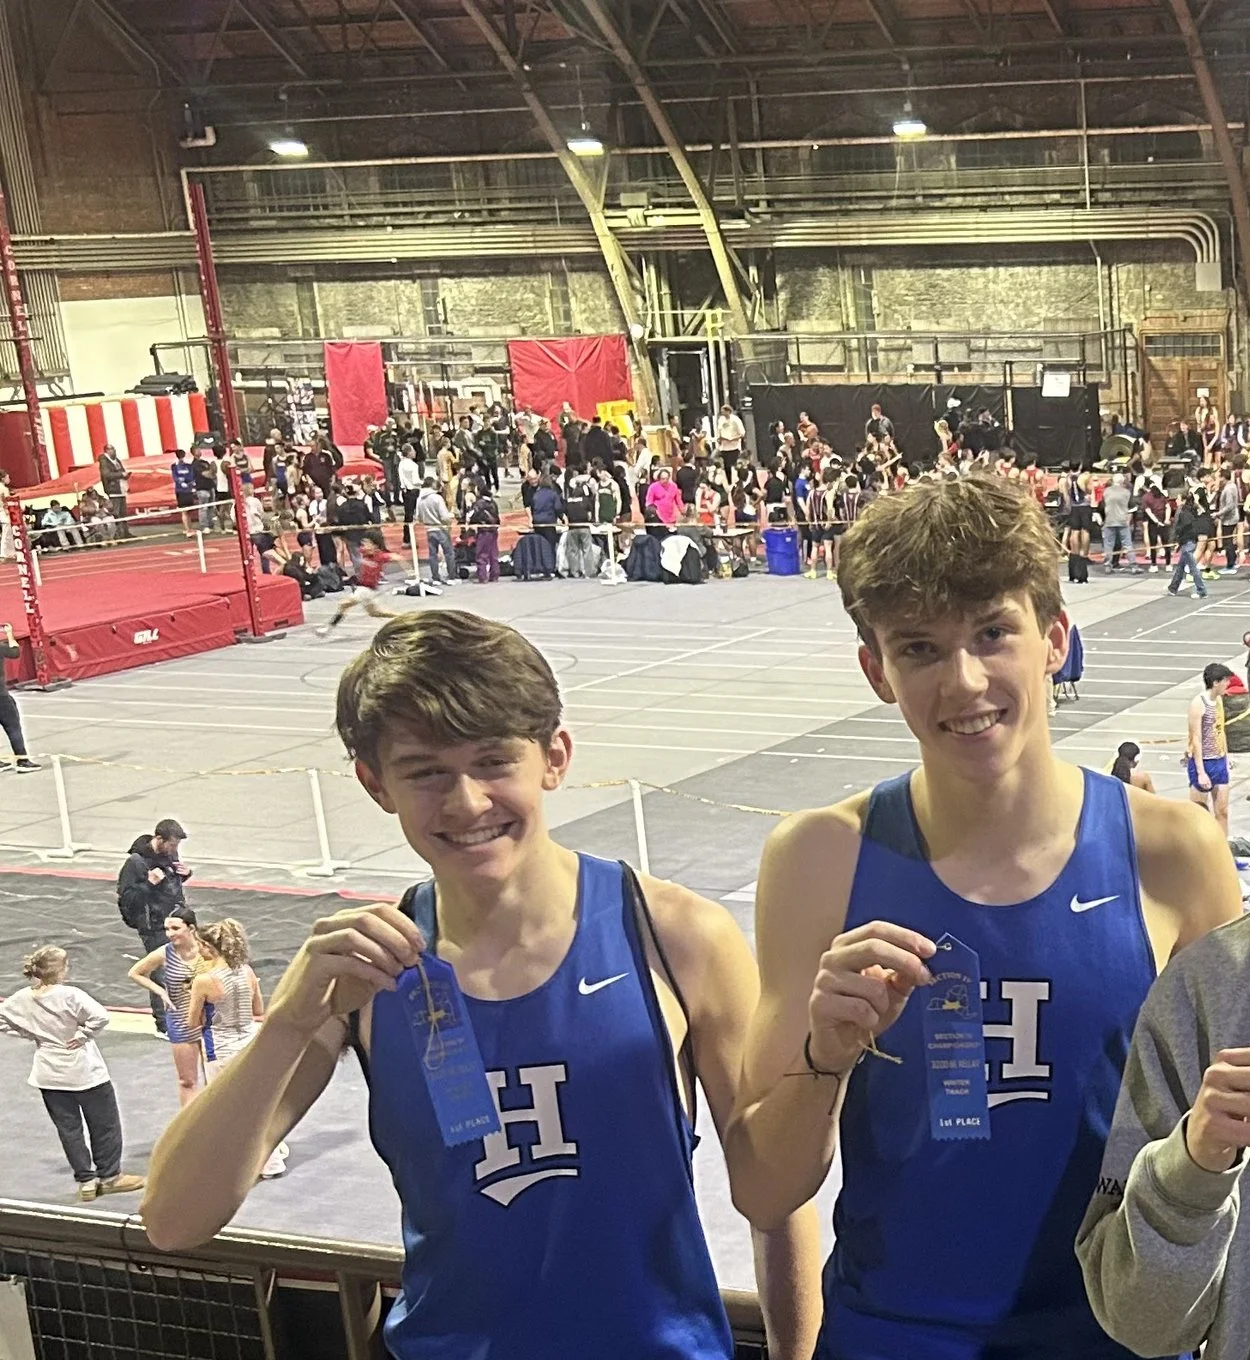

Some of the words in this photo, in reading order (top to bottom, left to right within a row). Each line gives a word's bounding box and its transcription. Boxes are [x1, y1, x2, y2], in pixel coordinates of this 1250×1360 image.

[12, 524, 35, 614] CORNELL
[475, 1064, 577, 1181] H
[940, 1118, 953, 1127] 1st
[956, 1117, 981, 1126] PLACE
